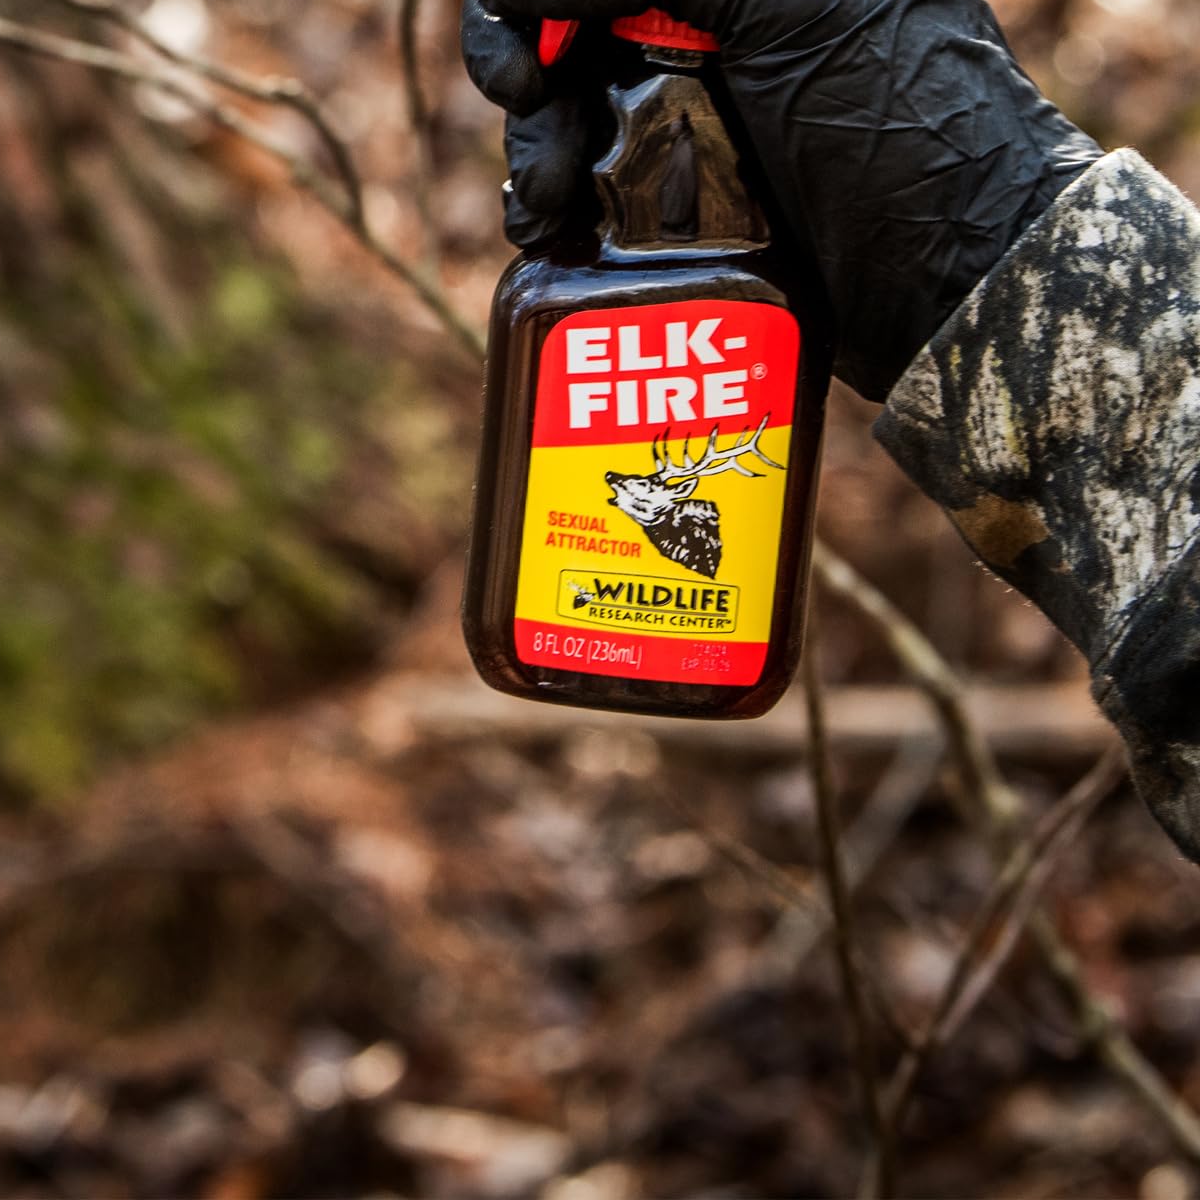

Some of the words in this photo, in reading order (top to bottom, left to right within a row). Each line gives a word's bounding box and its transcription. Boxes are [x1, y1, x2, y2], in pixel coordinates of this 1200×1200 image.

[566, 318, 747, 374] ELK-
[547, 510, 609, 533] SEXUAL
[545, 531, 641, 558] ATTRACTOR
[594, 578, 730, 612] WILDLIFE
[589, 607, 664, 625] RESEARCH
[533, 632, 543, 651] 8
[545, 633, 560, 654] FL
[563, 636, 586, 658] OZ
[586, 640, 642, 670] (236mL)
